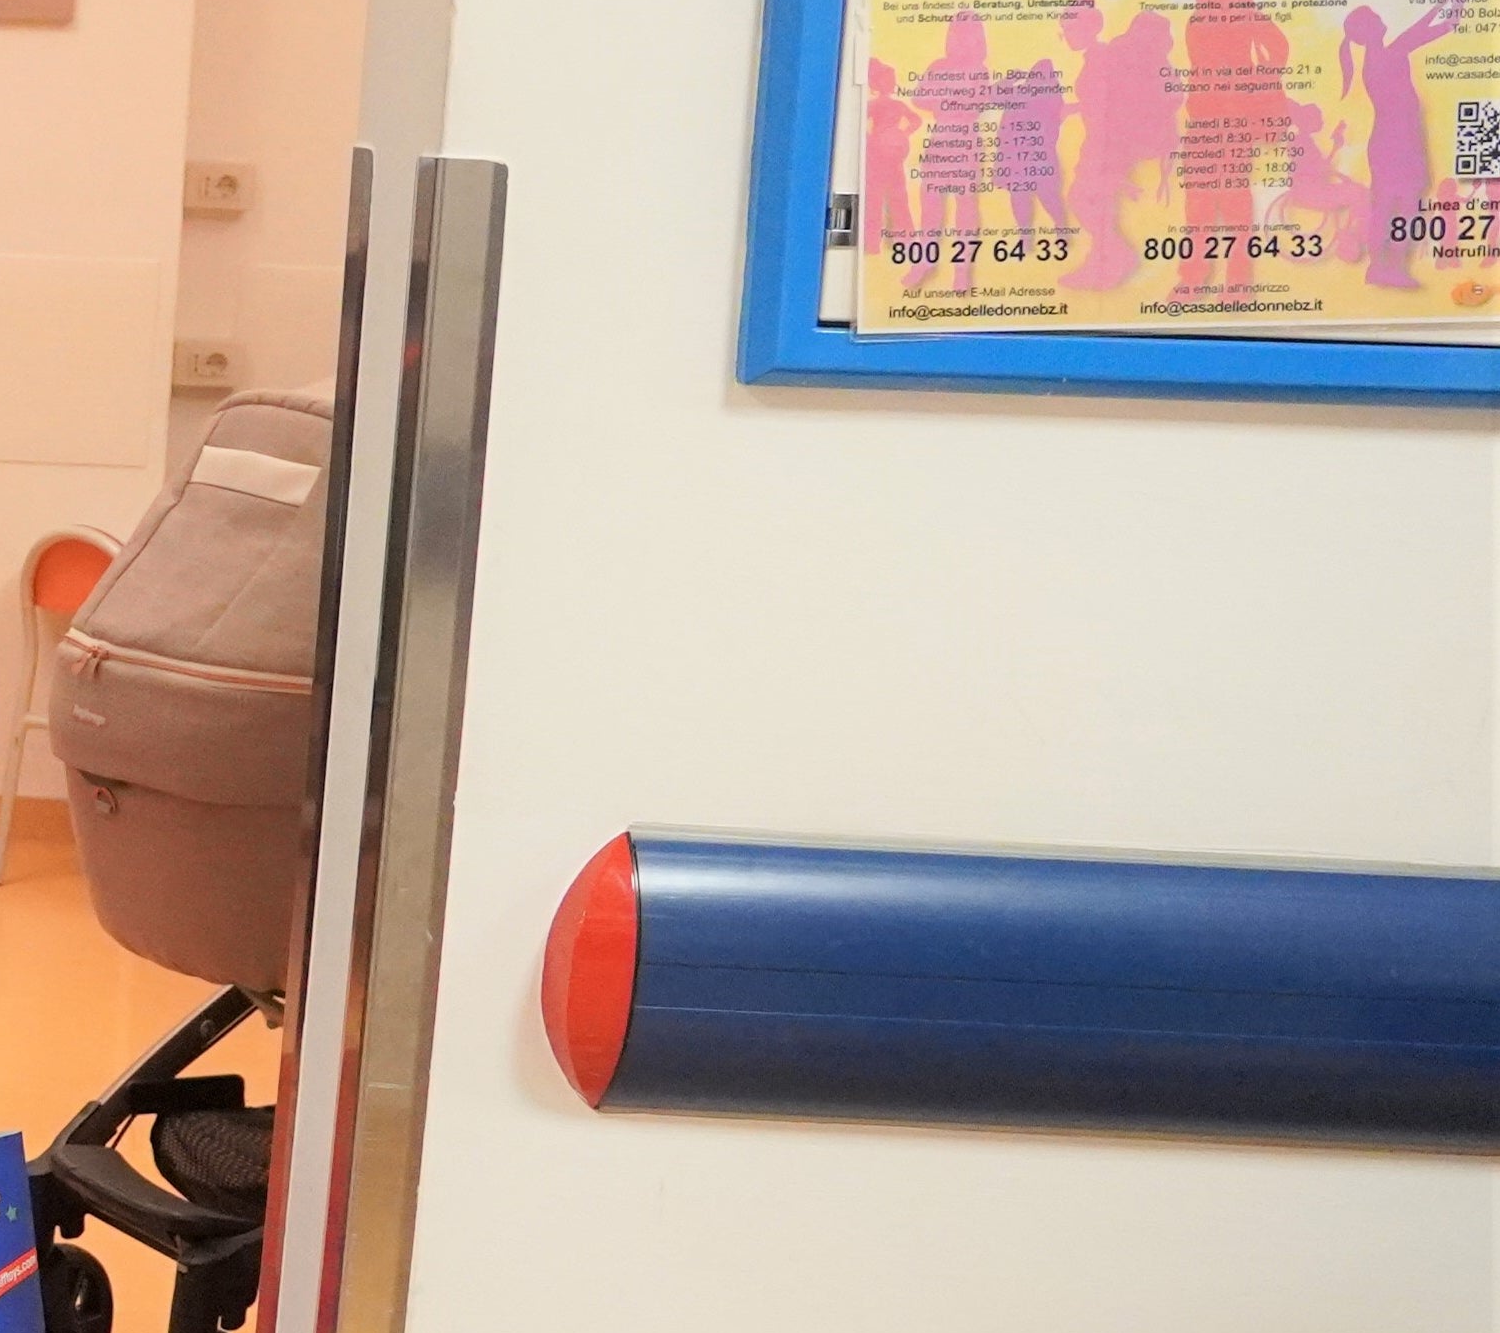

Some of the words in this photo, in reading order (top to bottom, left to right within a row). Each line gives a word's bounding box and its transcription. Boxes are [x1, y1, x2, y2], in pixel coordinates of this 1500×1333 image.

[1438, 7, 1475, 19] 39100
[1417, 198, 1460, 212] Linea
[1390, 216, 1446, 242] 800
[1457, 215, 1496, 241] 27
[891, 242, 940, 264] 800
[951, 240, 983, 263] 27
[993, 239, 1026, 262] 64
[1036, 238, 1068, 261] 33
[1144, 237, 1194, 260] 800
[1204, 236, 1237, 259] 27
[1247, 235, 1280, 258] 64
[1291, 234, 1323, 258] 33
[902, 288, 922, 299] Auf
[924, 289, 966, 299] unserer
[971, 287, 1006, 297] E-Mail
[1009, 286, 1056, 297] Adresse
[889, 303, 1068, 321] info@casadelledonnebz.it
[1140, 298, 1323, 316] info@casadelledonnebz.it
